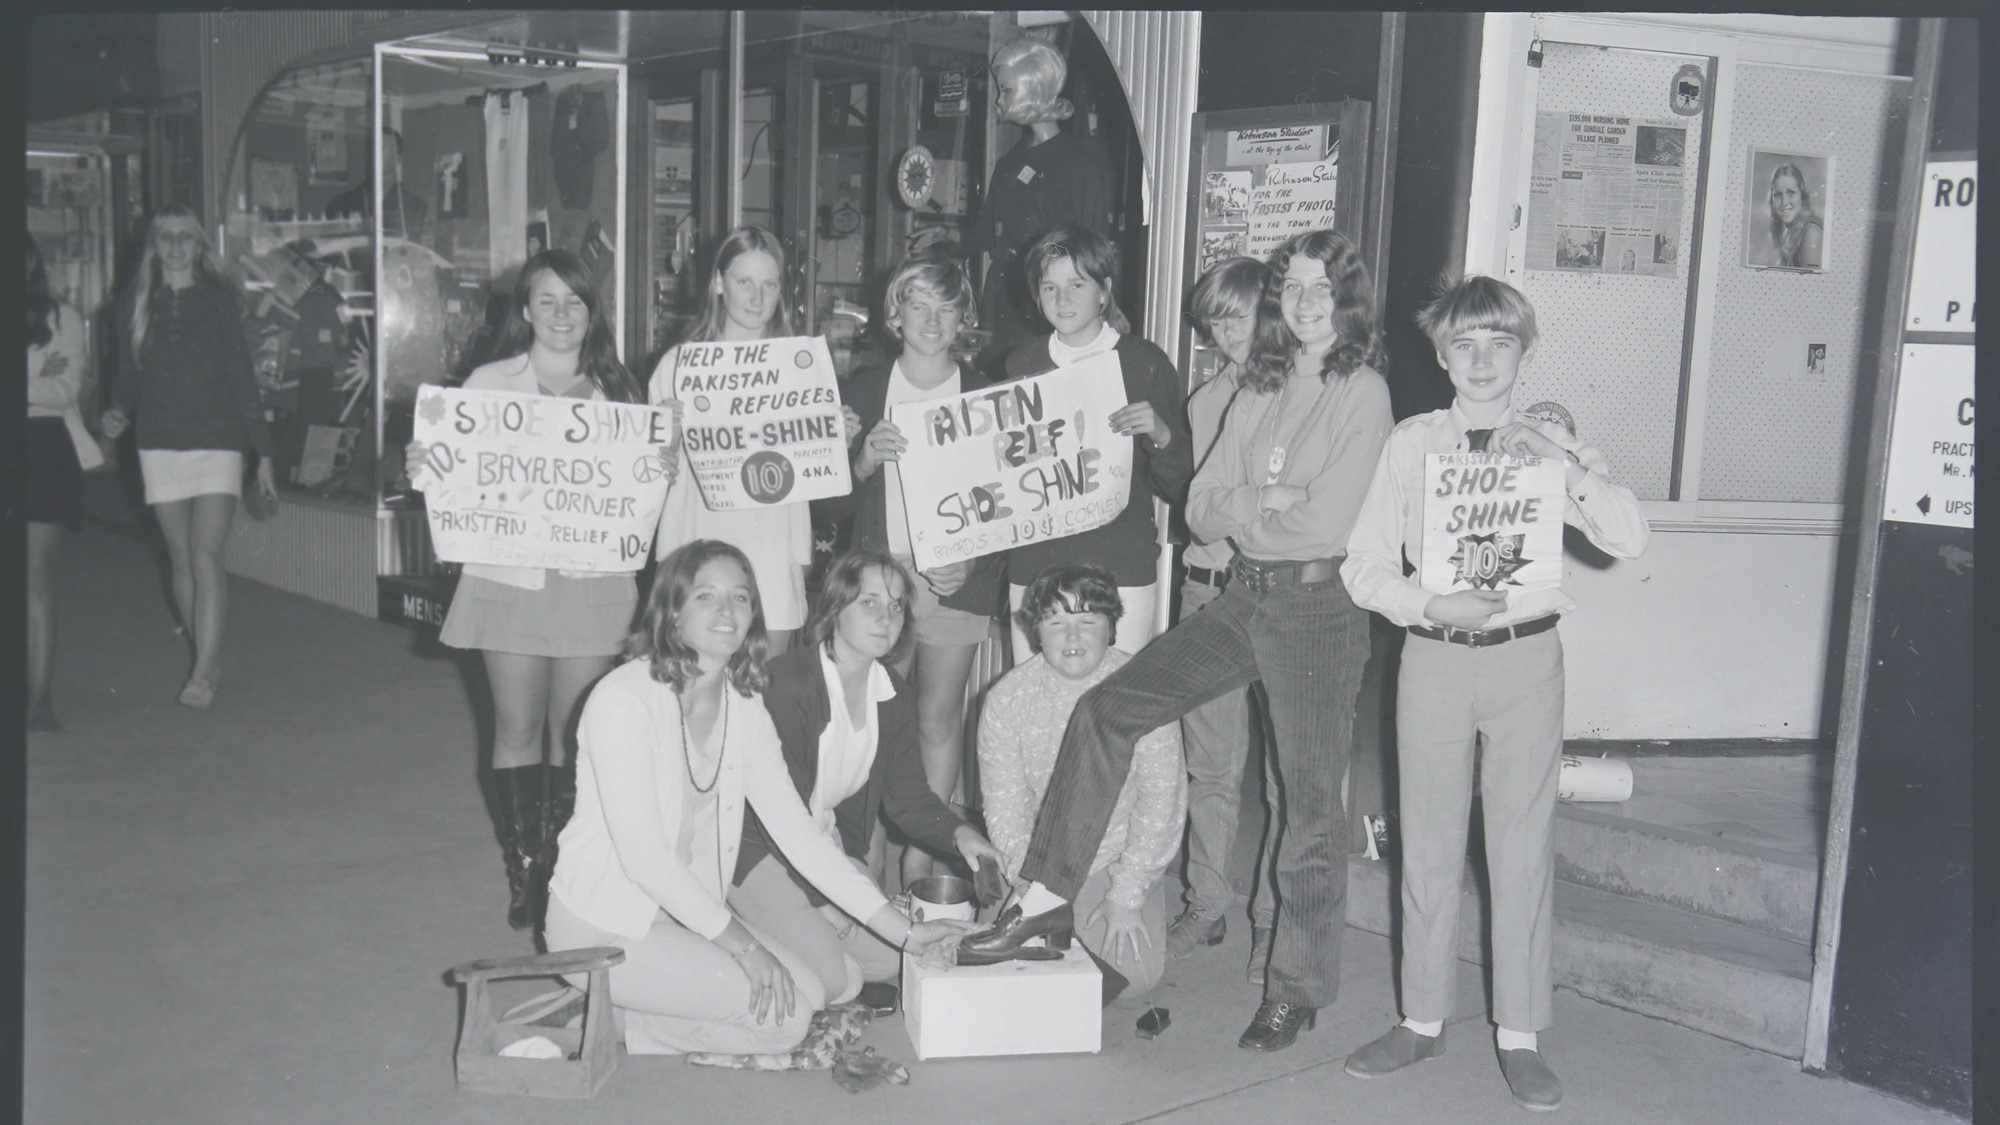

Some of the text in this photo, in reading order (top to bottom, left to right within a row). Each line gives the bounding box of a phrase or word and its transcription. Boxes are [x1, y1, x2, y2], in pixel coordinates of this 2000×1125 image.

[1568, 114, 1630, 126] $195,000 NURSING HOME
[1571, 124, 1627, 135] FOR SUNDALE GARDEN
[1237, 127, 1314, 141] Robinson Studios
[1576, 134, 1619, 145] VILLAGE PLANNED
[1265, 167, 1312, 186] Robinson
[1253, 189, 1292, 199] FOR THE
[1935, 177, 1975, 207] RO
[1252, 201, 1295, 216] FASTEST
[1267, 220, 1280, 229] THE
[1287, 220, 1312, 228] TOWN
[678, 344, 770, 367] HELP THE
[680, 369, 780, 392] PAKISTAN
[730, 387, 835, 416] REFUGEES
[1535, 402, 1573, 424] NAMBOUR
[455, 400, 666, 444] SHOE SHINE
[924, 381, 1043, 448] PAKISTAN
[686, 416, 838, 451] SHOE-SHINE
[793, 448, 832, 458] PUBLICITY
[1932, 441, 1975, 457] PRACT
[477, 451, 612, 488] BAYARD'S
[937, 448, 1102, 535] SHOE SHINE
[1436, 466, 1521, 498] SHOE
[544, 489, 636, 517] CORNER
[1065, 491, 1124, 527] CORNER
[1945, 500, 1973, 516] UPS
[1446, 498, 1542, 533] SHINE
[550, 525, 609, 545] RELIEF
[404, 593, 443, 626] MENS
